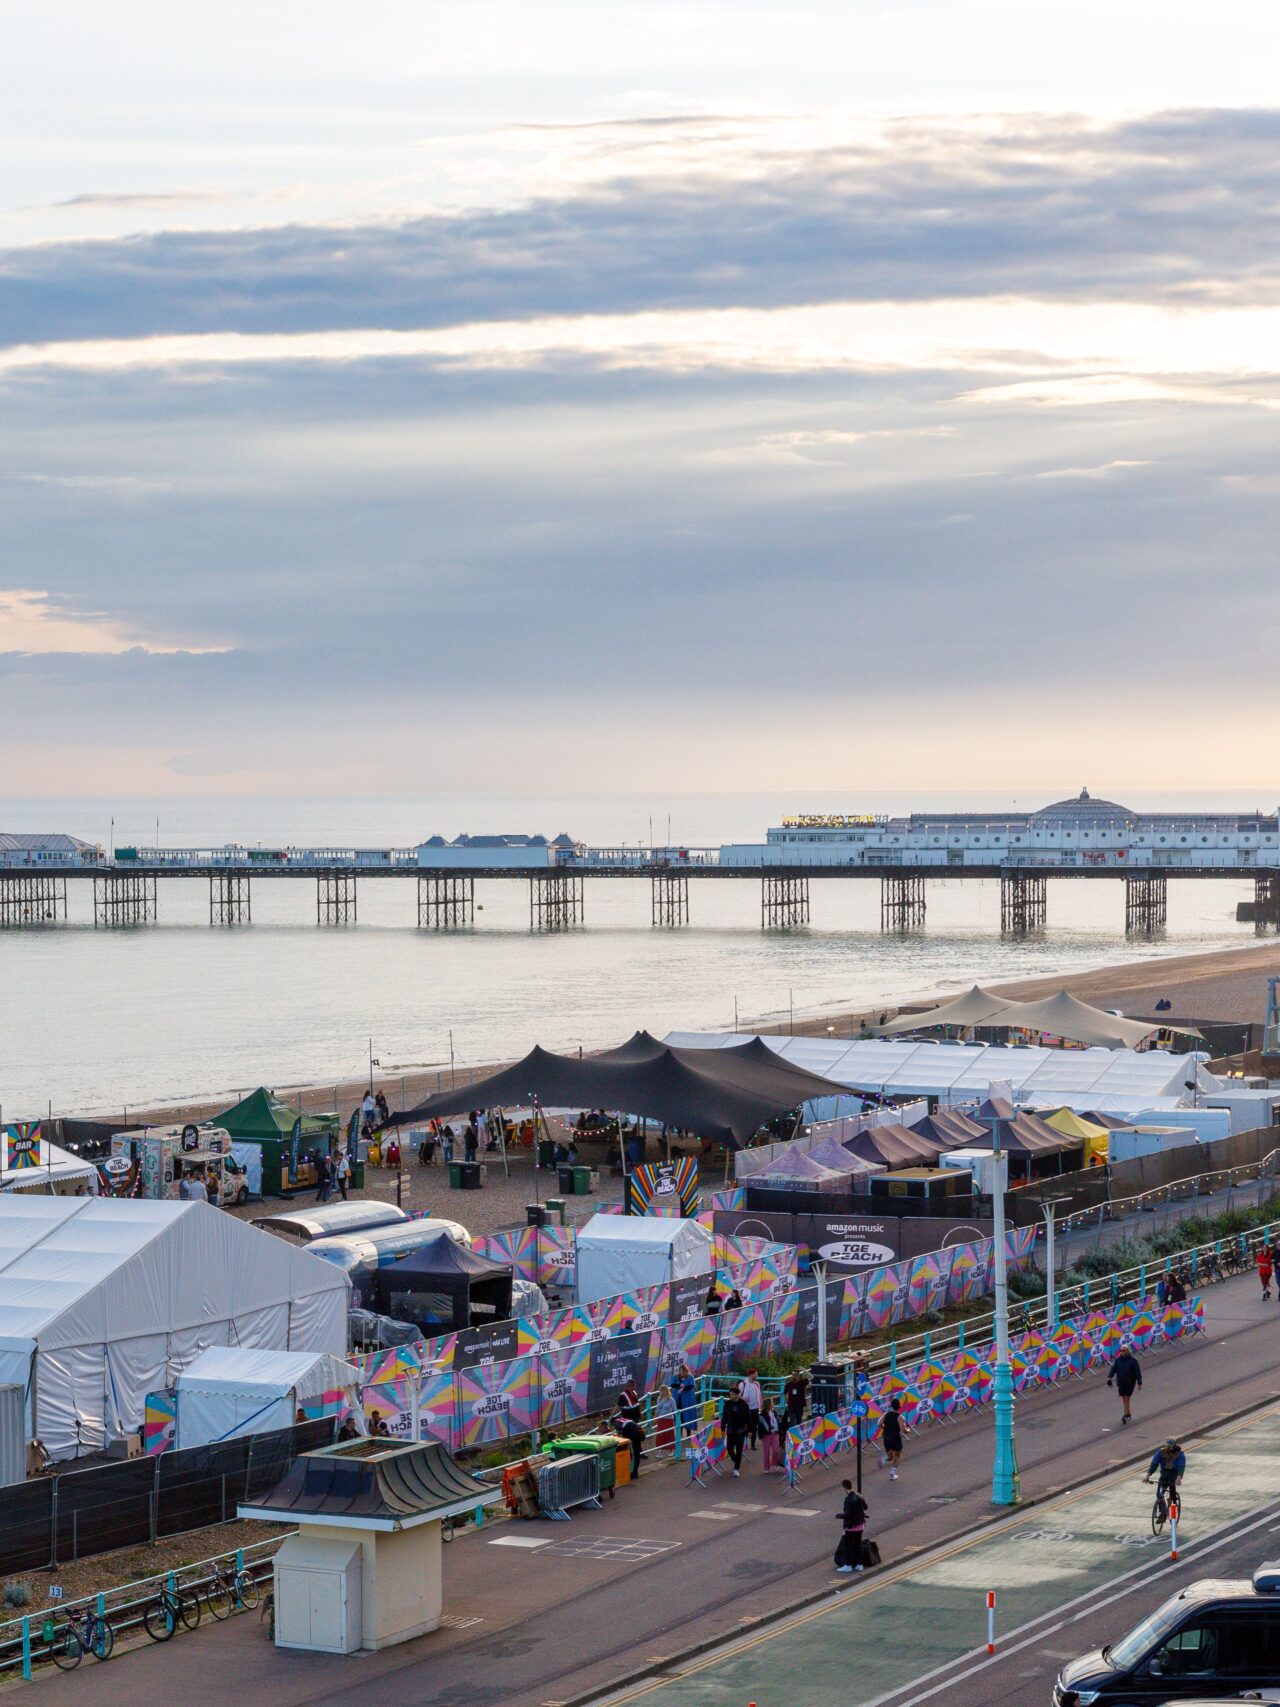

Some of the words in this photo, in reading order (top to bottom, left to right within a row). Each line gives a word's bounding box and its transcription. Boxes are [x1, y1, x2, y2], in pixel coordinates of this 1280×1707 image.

[15, 1140, 32, 1151] BAR
[661, 1178, 671, 1186] TGE
[657, 1184, 675, 1193] BEACH
[826, 1223, 857, 1232] amazon
[858, 1223, 884, 1232] music
[842, 1244, 870, 1252] TGE
[830, 1252, 883, 1261] BEACH
[640, 1313, 651, 1321] TGE
[635, 1319, 656, 1331] BEACH
[591, 1328, 603, 1337] TGE
[540, 1341, 551, 1350] TGE
[812, 1403, 826, 1414] 23
[51, 1587, 61, 1597] 13
